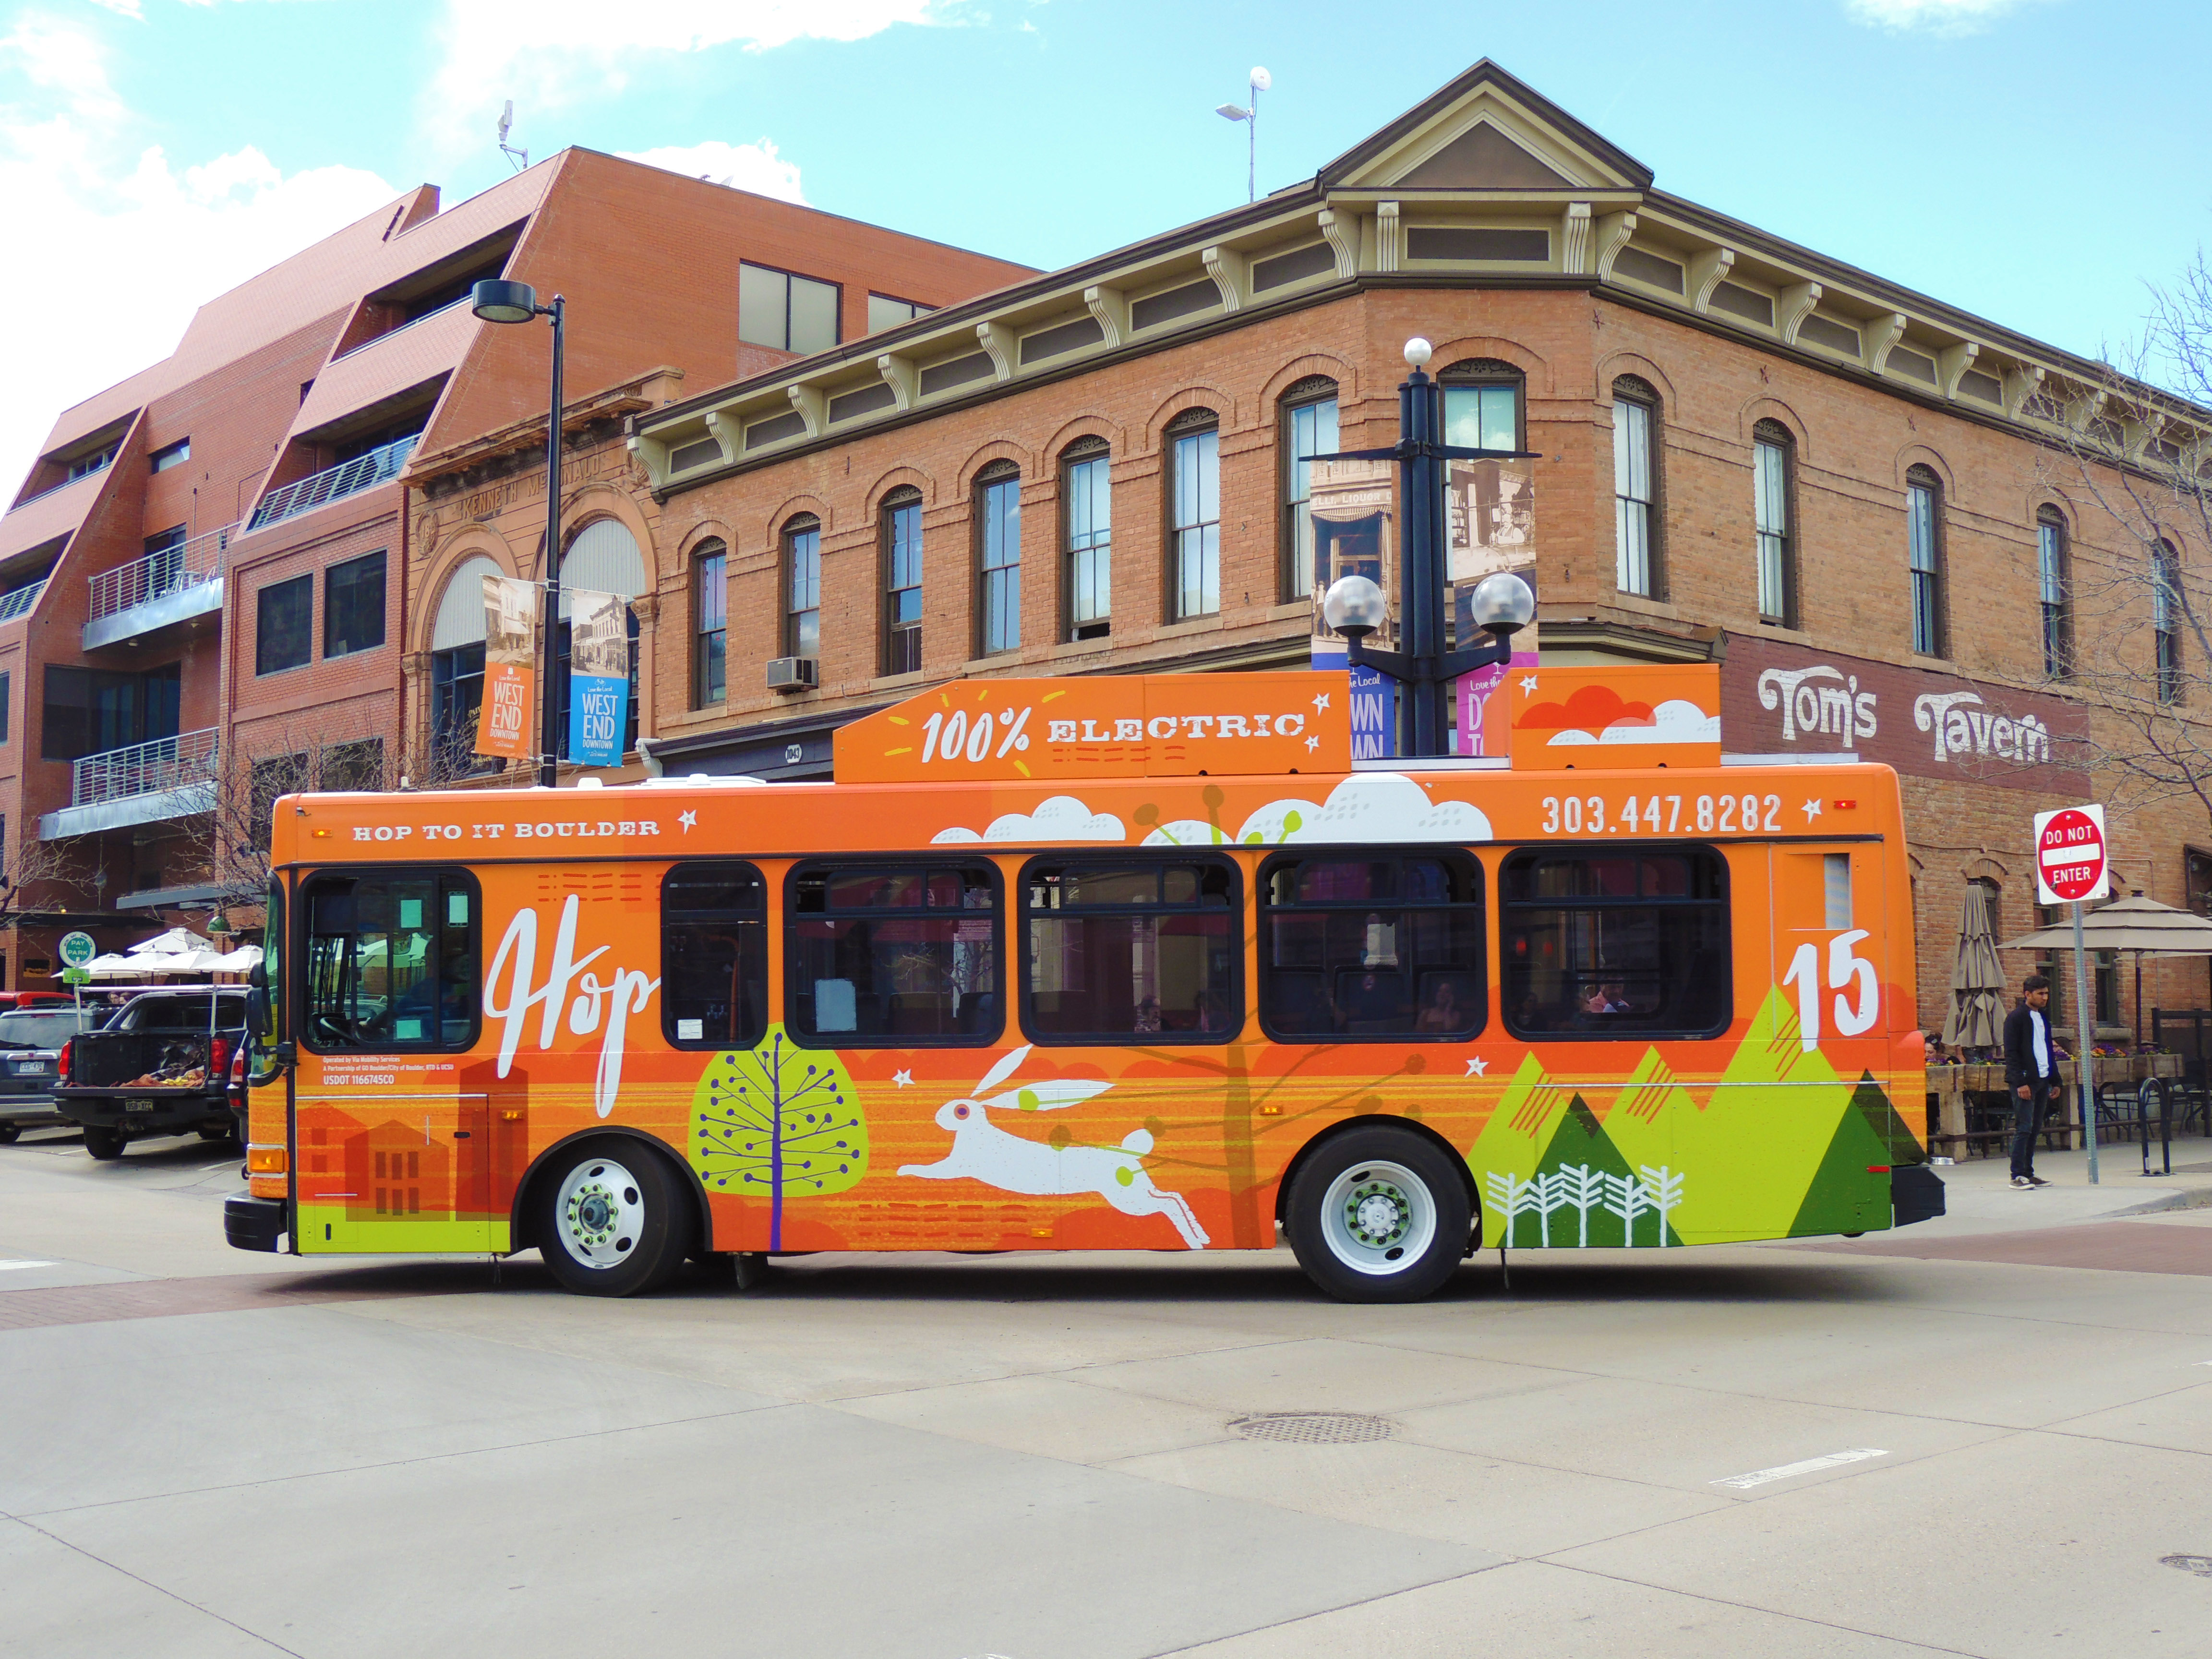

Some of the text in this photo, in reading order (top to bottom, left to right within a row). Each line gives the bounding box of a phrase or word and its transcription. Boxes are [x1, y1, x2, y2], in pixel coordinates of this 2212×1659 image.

[464, 455, 600, 519] KENNETH McNALD
[1342, 492, 1380, 503] LIQUOR
[1349, 673, 1381, 688] he Local
[1470, 680, 1490, 691] Love
[494, 681, 525, 706] WEST
[582, 693, 618, 716] WEST
[1758, 666, 2050, 762] Tom's Tavern
[491, 703, 522, 731] END
[583, 715, 615, 740] END
[490, 728, 519, 741] DOWNTOWN
[583, 739, 613, 750] DOWNTOWN
[922, 707, 1305, 763] 100% ELECTRIC
[787, 747, 799, 760] 1043
[1542, 794, 1781, 833] 303.447.8282
[353, 821, 660, 841] HOP TO IT BOULDER
[2046, 825, 2092, 845] DO NOT
[2053, 866, 2091, 884] ENTER
[1782, 929, 1879, 1053] 15
[484, 894, 661, 1118] Hop
[323, 1075, 350, 1085] USDOT
